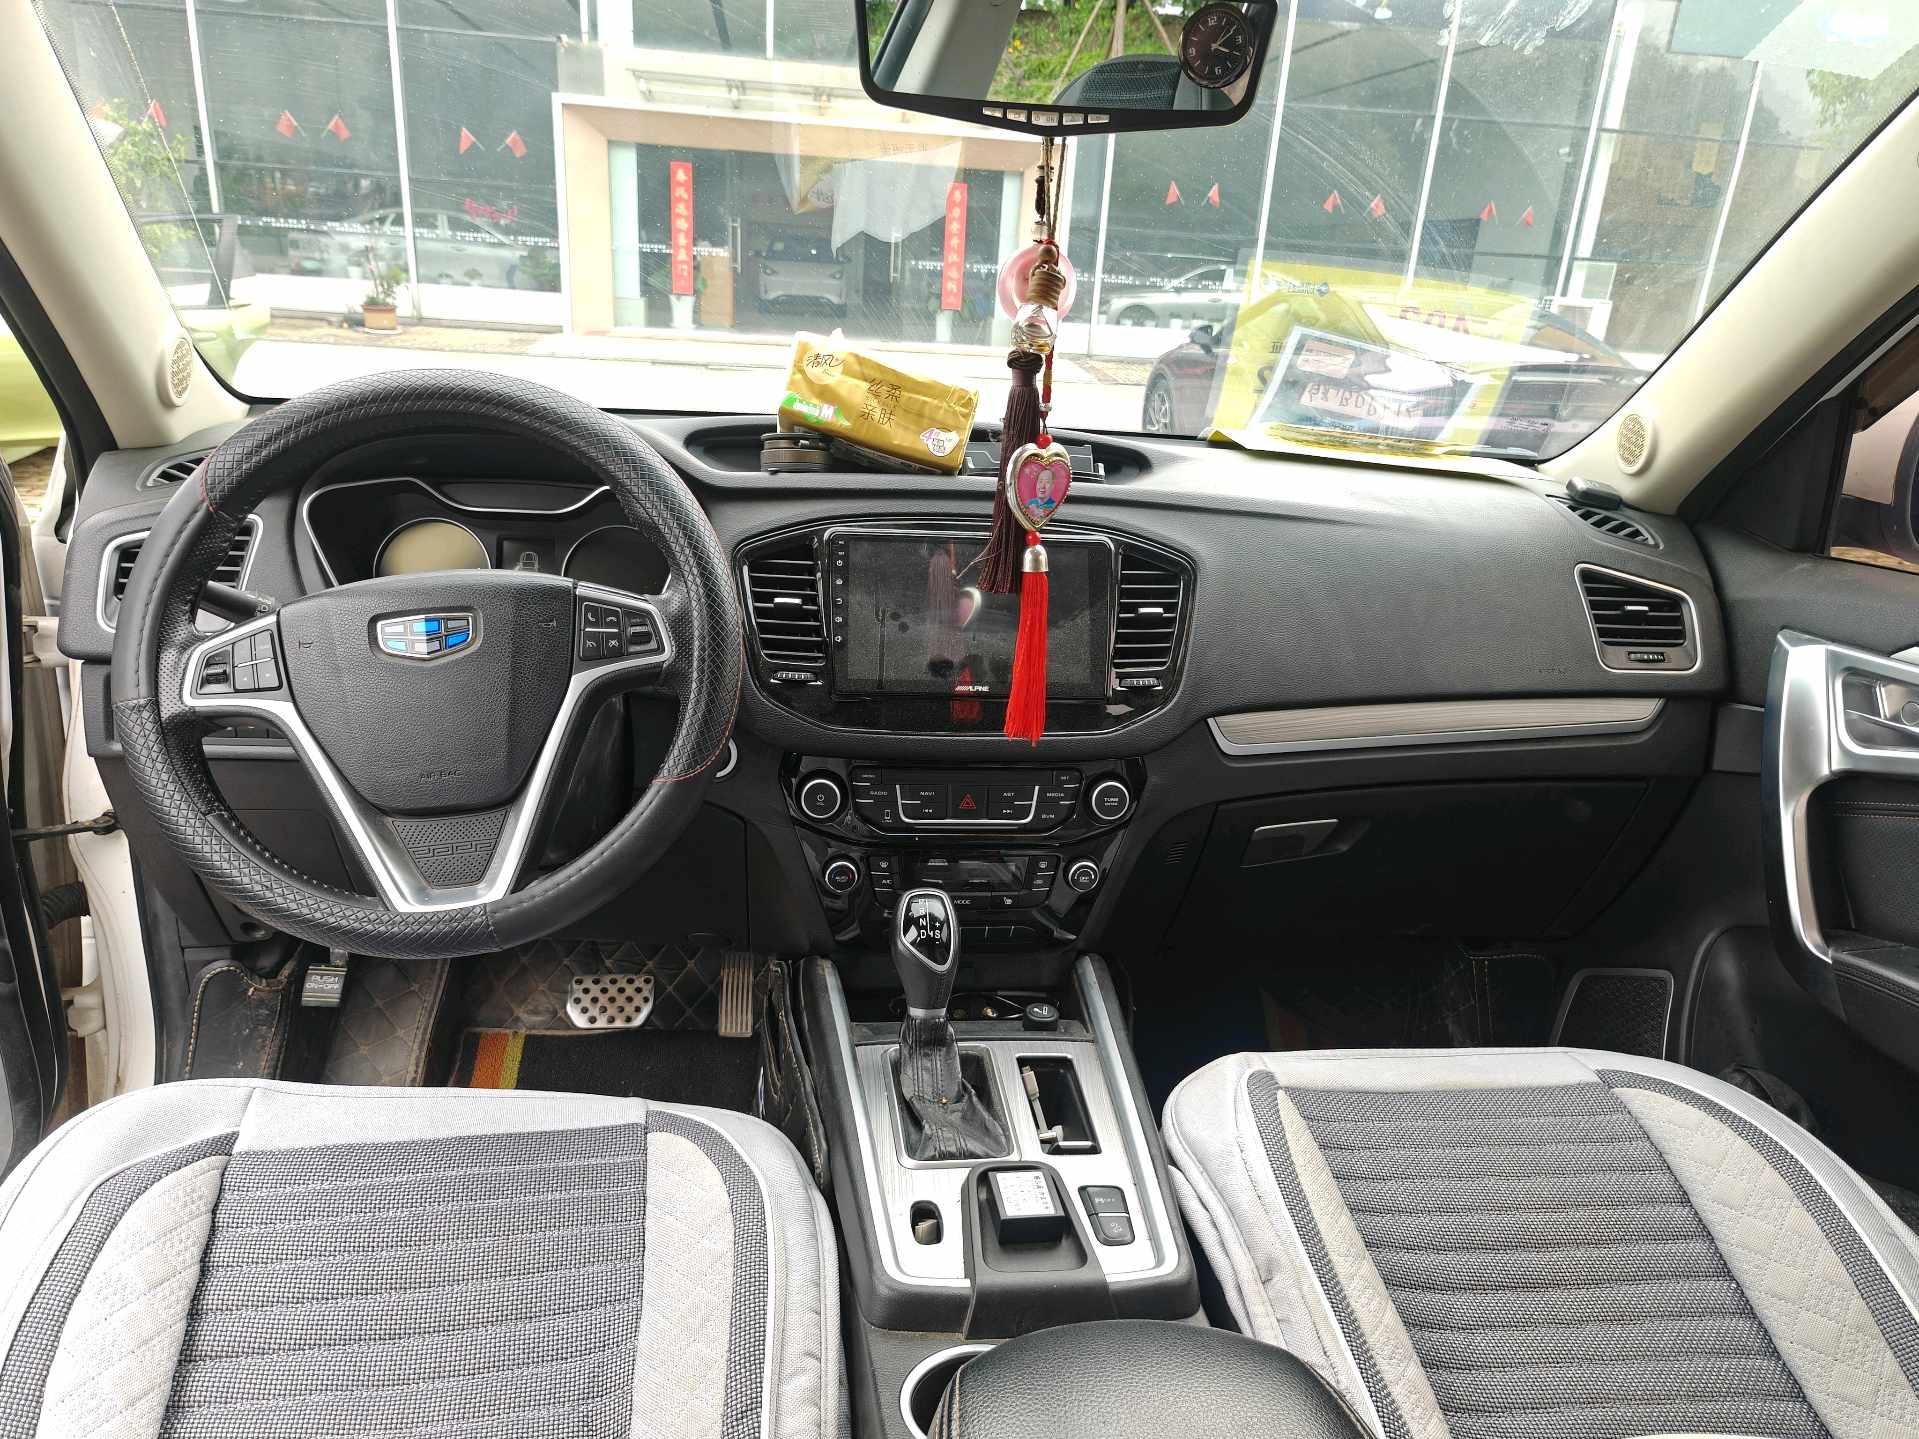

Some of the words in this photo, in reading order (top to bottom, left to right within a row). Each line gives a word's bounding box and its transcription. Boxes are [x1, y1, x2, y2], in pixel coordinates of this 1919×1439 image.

[1208, 16, 1217, 26] 12
[806, 353, 846, 368] 清风
[867, 378, 902, 401] 丝柔
[860, 404, 896, 428] 亲肤
[919, 917, 927, 926] N
[920, 929, 927, 939] D
[934, 929, 941, 939] S
